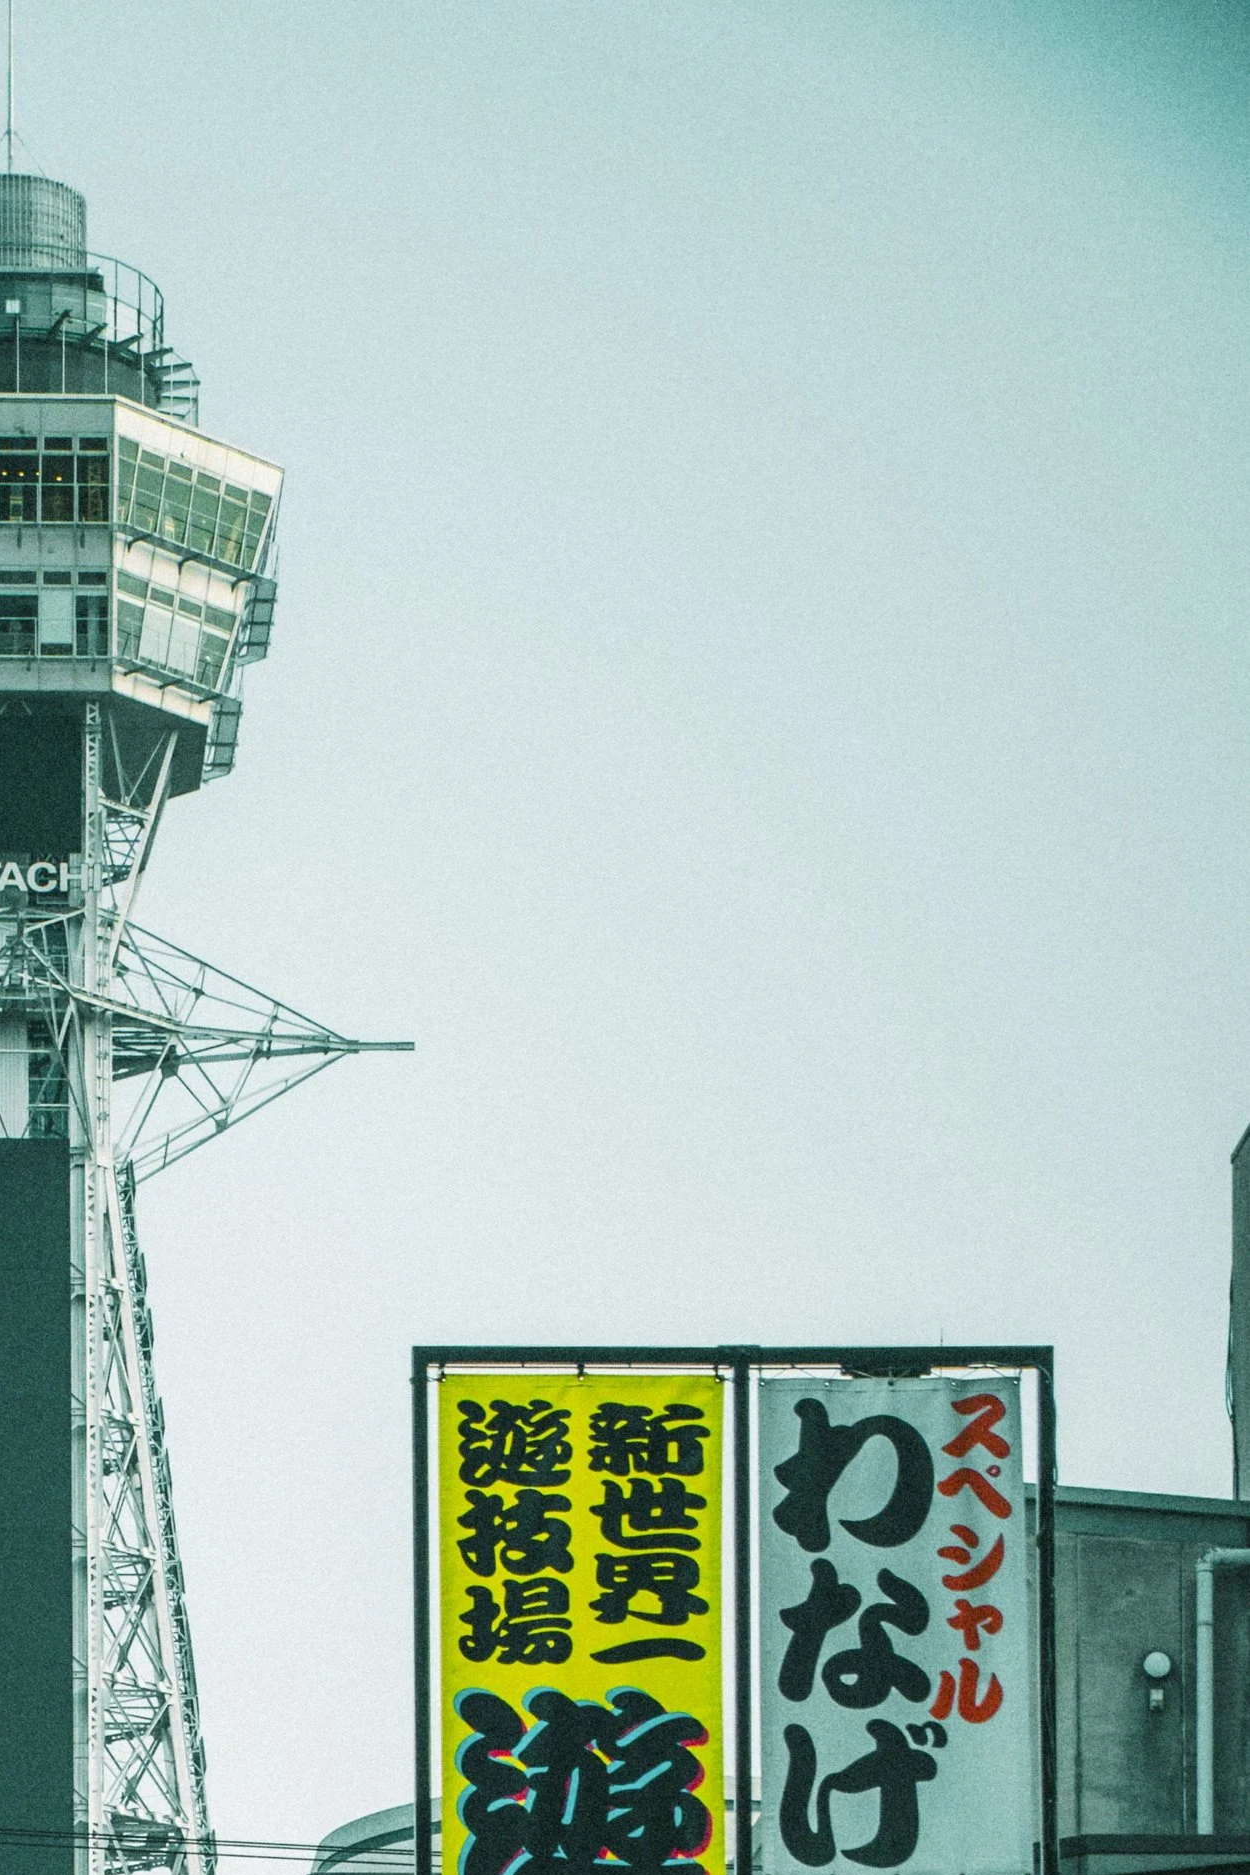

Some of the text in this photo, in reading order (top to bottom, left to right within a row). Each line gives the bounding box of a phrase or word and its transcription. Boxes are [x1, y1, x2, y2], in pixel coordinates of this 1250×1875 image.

[456, 1399, 573, 1665] 遊技場
[587, 1402, 710, 1664] 新世界一
[772, 1397, 947, 1868] わなげ
[930, 1392, 1013, 1724] スペシャル
